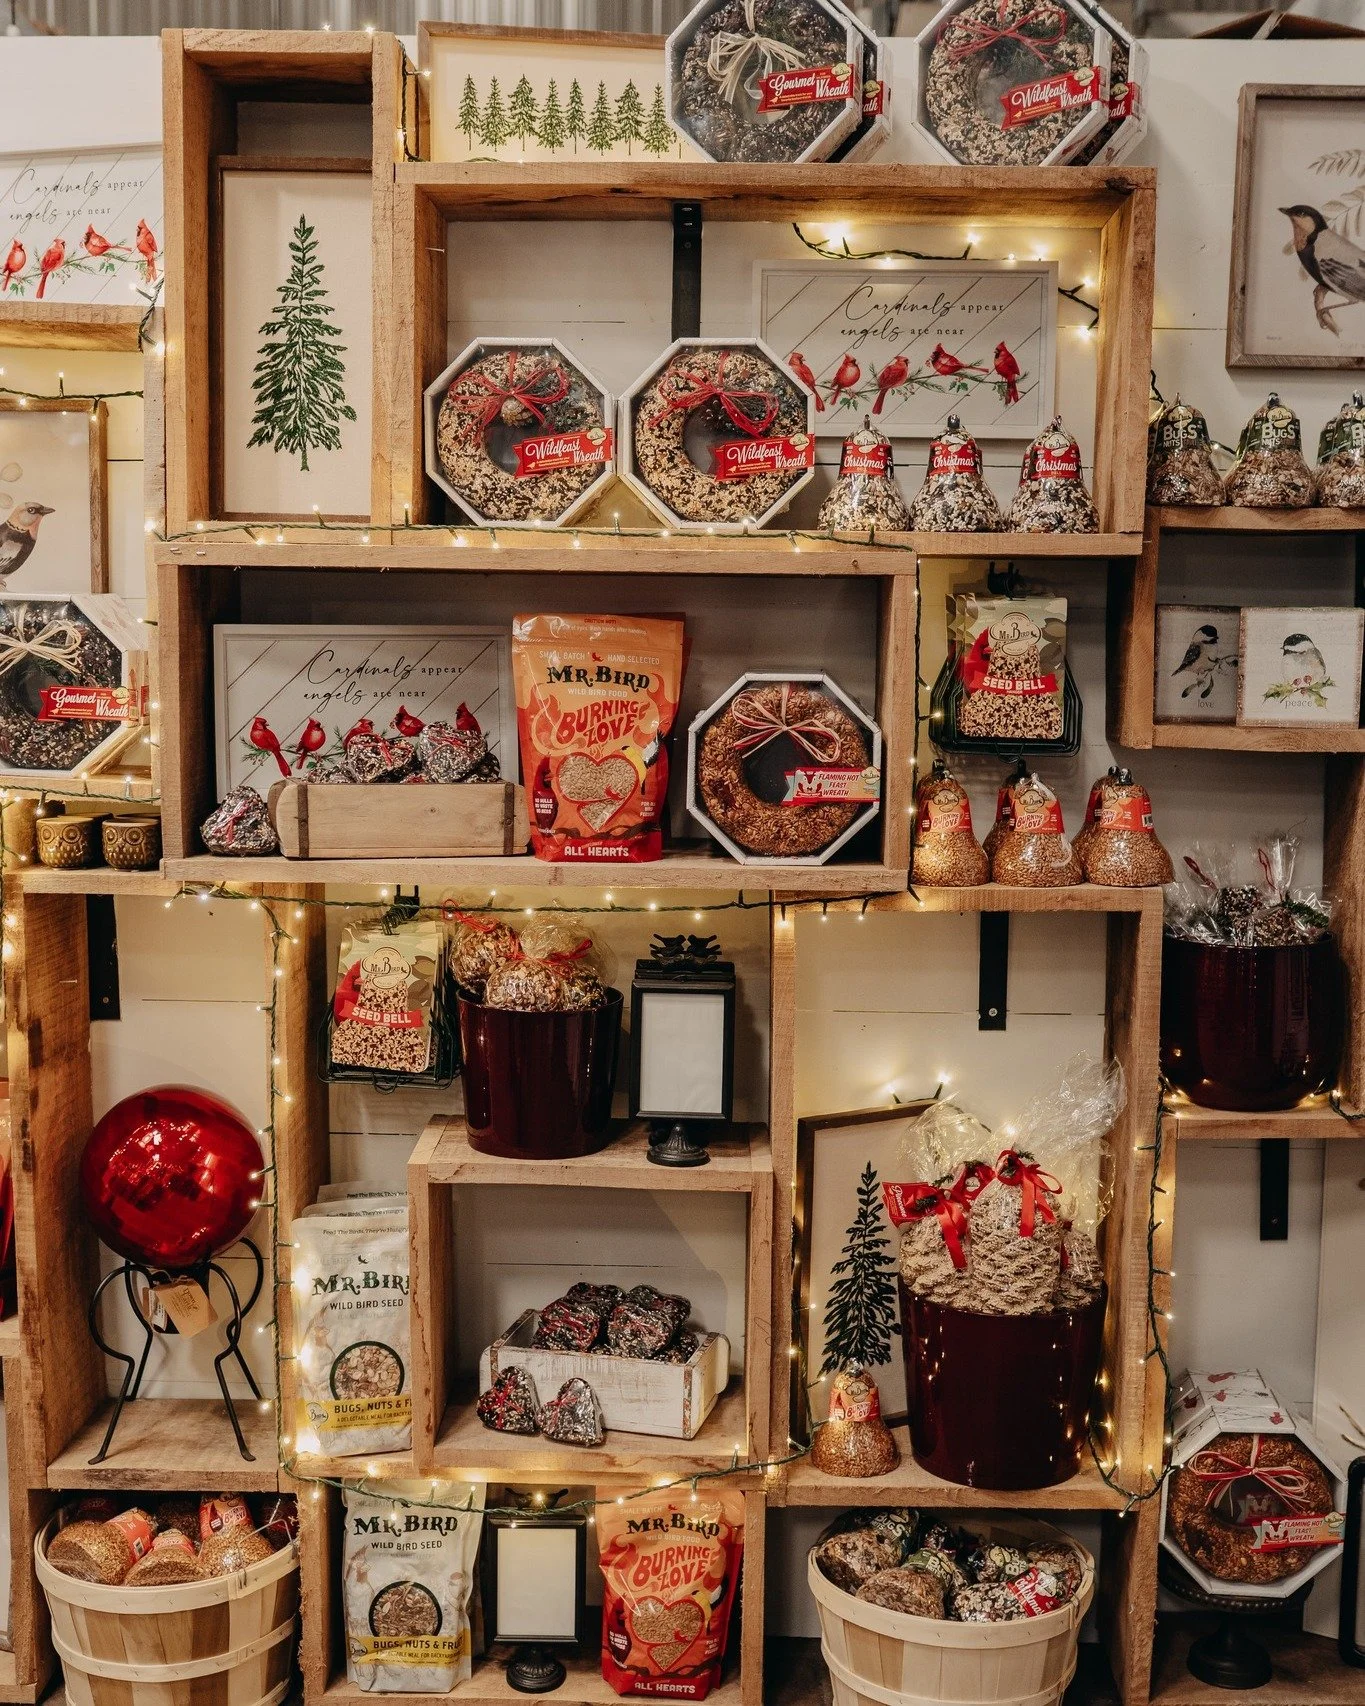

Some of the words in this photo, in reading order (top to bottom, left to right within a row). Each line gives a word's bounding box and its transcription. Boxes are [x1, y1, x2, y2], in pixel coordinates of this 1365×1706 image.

[769, 73, 816, 97] Gourmet
[815, 78, 850, 98] Wreath
[1011, 80, 1068, 108] Wildfeast
[1060, 85, 1093, 108] Wreath
[13, 168, 101, 204] Cardinals
[107, 180, 144, 191] appear
[10, 200, 61, 234] angels
[66, 208, 82, 216] are
[87, 207, 111, 215] near
[845, 285, 957, 321] Cardinals
[960, 303, 1004, 313] appear
[840, 318, 903, 349] angels
[910, 327, 930, 335] are
[525, 437, 581, 460] Wildfeast
[573, 447, 605, 464] Wreath
[727, 443, 783, 461] Wildfeast
[775, 452, 807, 470] Wreath
[844, 455, 885, 470] Christmas
[933, 454, 975, 469] Christmas
[1035, 460, 1077, 472] Christmas
[564, 651, 586, 661] BATCH
[627, 656, 660, 665] SELECTED
[307, 649, 416, 685] Cardinals
[421, 667, 463, 676] appear
[982, 676, 1013, 691] SEED
[1015, 678, 1046, 691] BELL
[303, 681, 367, 714] angels
[399, 690, 427, 698] near
[588, 688, 607, 696] BIRD
[608, 689, 628, 698] FOOD
[50, 688, 97, 708] Gourmet
[95, 698, 130, 717] Wreath
[1197, 699, 1215, 709] love
[1284, 699, 1313, 710] peace
[556, 700, 639, 745] BURNING
[583, 714, 638, 748] LOVE
[818, 773, 847, 781] FLAMING
[846, 774, 860, 782] HOT
[564, 846, 585, 857] ALL
[587, 845, 629, 857] HEARTS
[351, 1006, 381, 1022] SEED
[383, 1012, 412, 1024] BELL
[330, 1301, 353, 1310] WILD
[356, 1300, 379, 1309] BIRD
[381, 1299, 404, 1308] SEED
[334, 1403, 365, 1414] BUGS,
[367, 1400, 393, 1411] NUTS
[395, 1399, 402, 1409] &
[371, 1541, 394, 1549] WILD
[396, 1542, 418, 1551] BIRD
[420, 1540, 443, 1550] SEED
[682, 1535, 701, 1544] FOOD
[632, 1545, 711, 1588] BURNING
[657, 1560, 709, 1592] LOVE
[405, 1640, 430, 1649] NUTS
[432, 1641, 440, 1649] &
[634, 1682, 653, 1691] ALL
[655, 1683, 696, 1694] HEARTS
